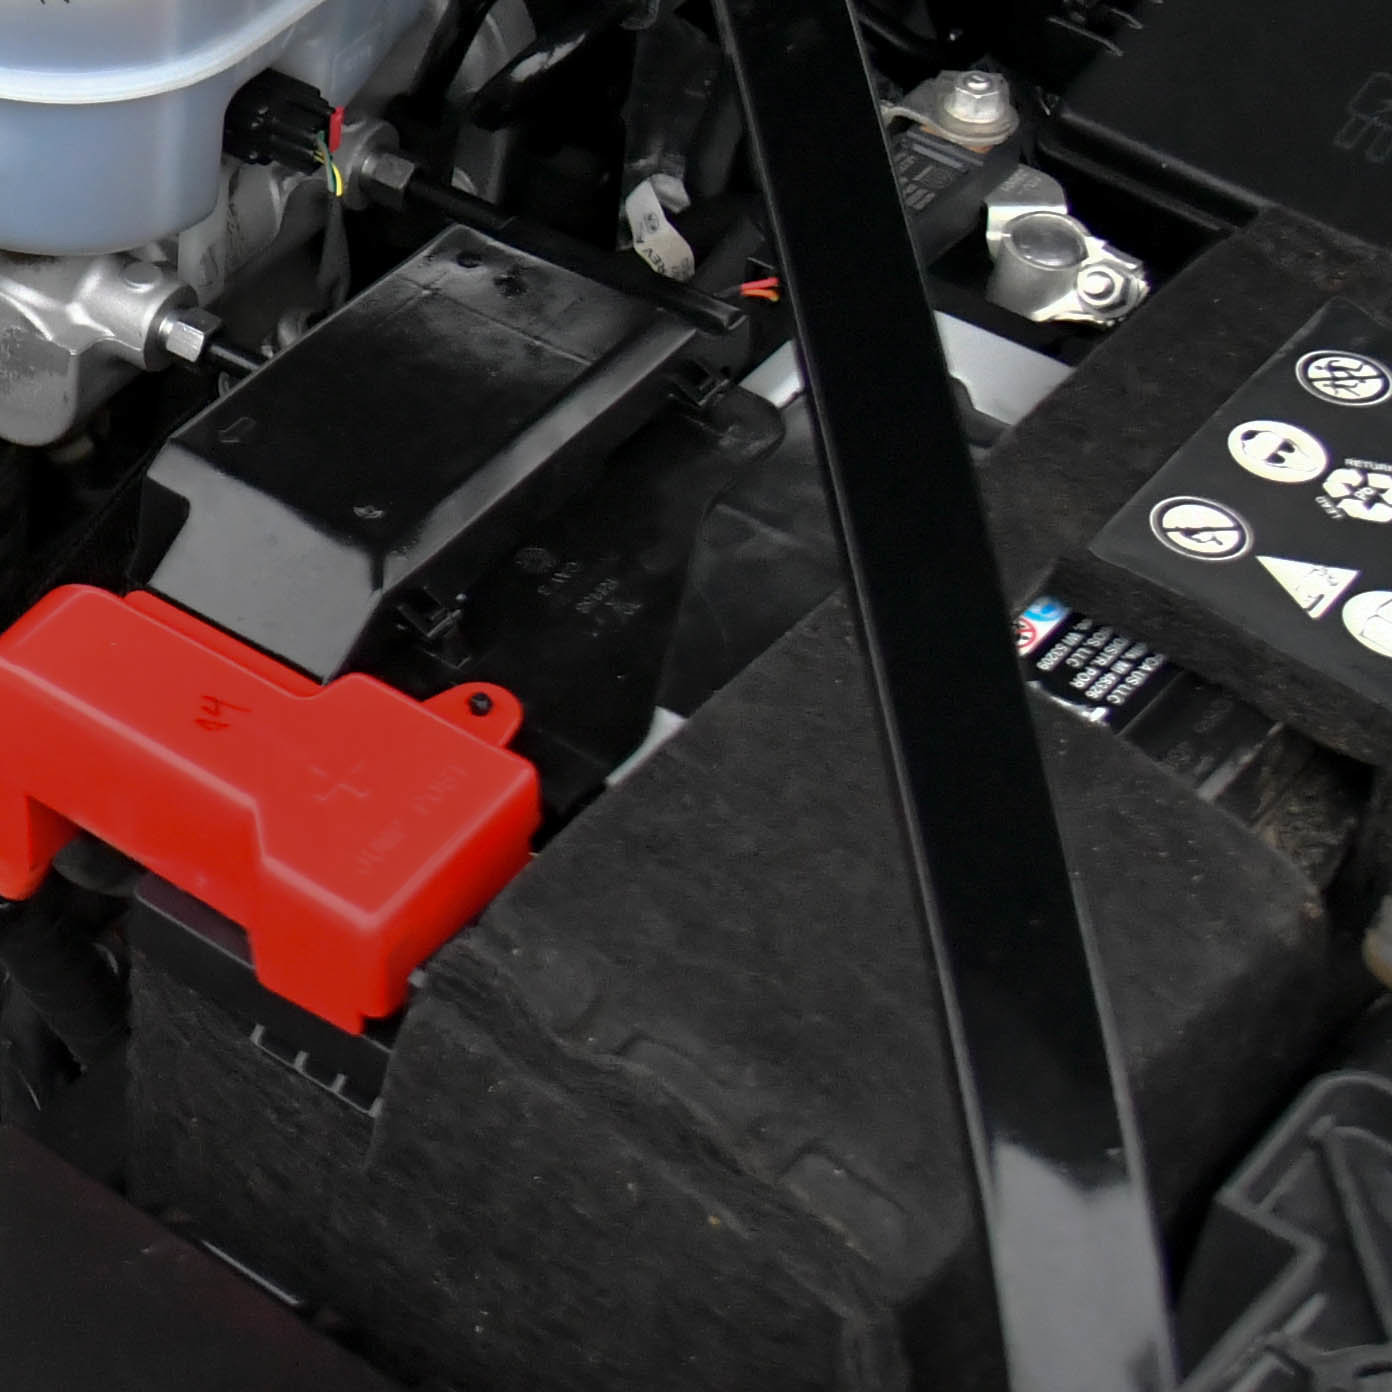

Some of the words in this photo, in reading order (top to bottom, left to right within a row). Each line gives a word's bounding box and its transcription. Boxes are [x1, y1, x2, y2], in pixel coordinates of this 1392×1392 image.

[1066, 647, 1094, 668] LLC
[1069, 667, 1101, 689] POR
[1125, 671, 1147, 685] US
[1107, 684, 1131, 705] LLC
